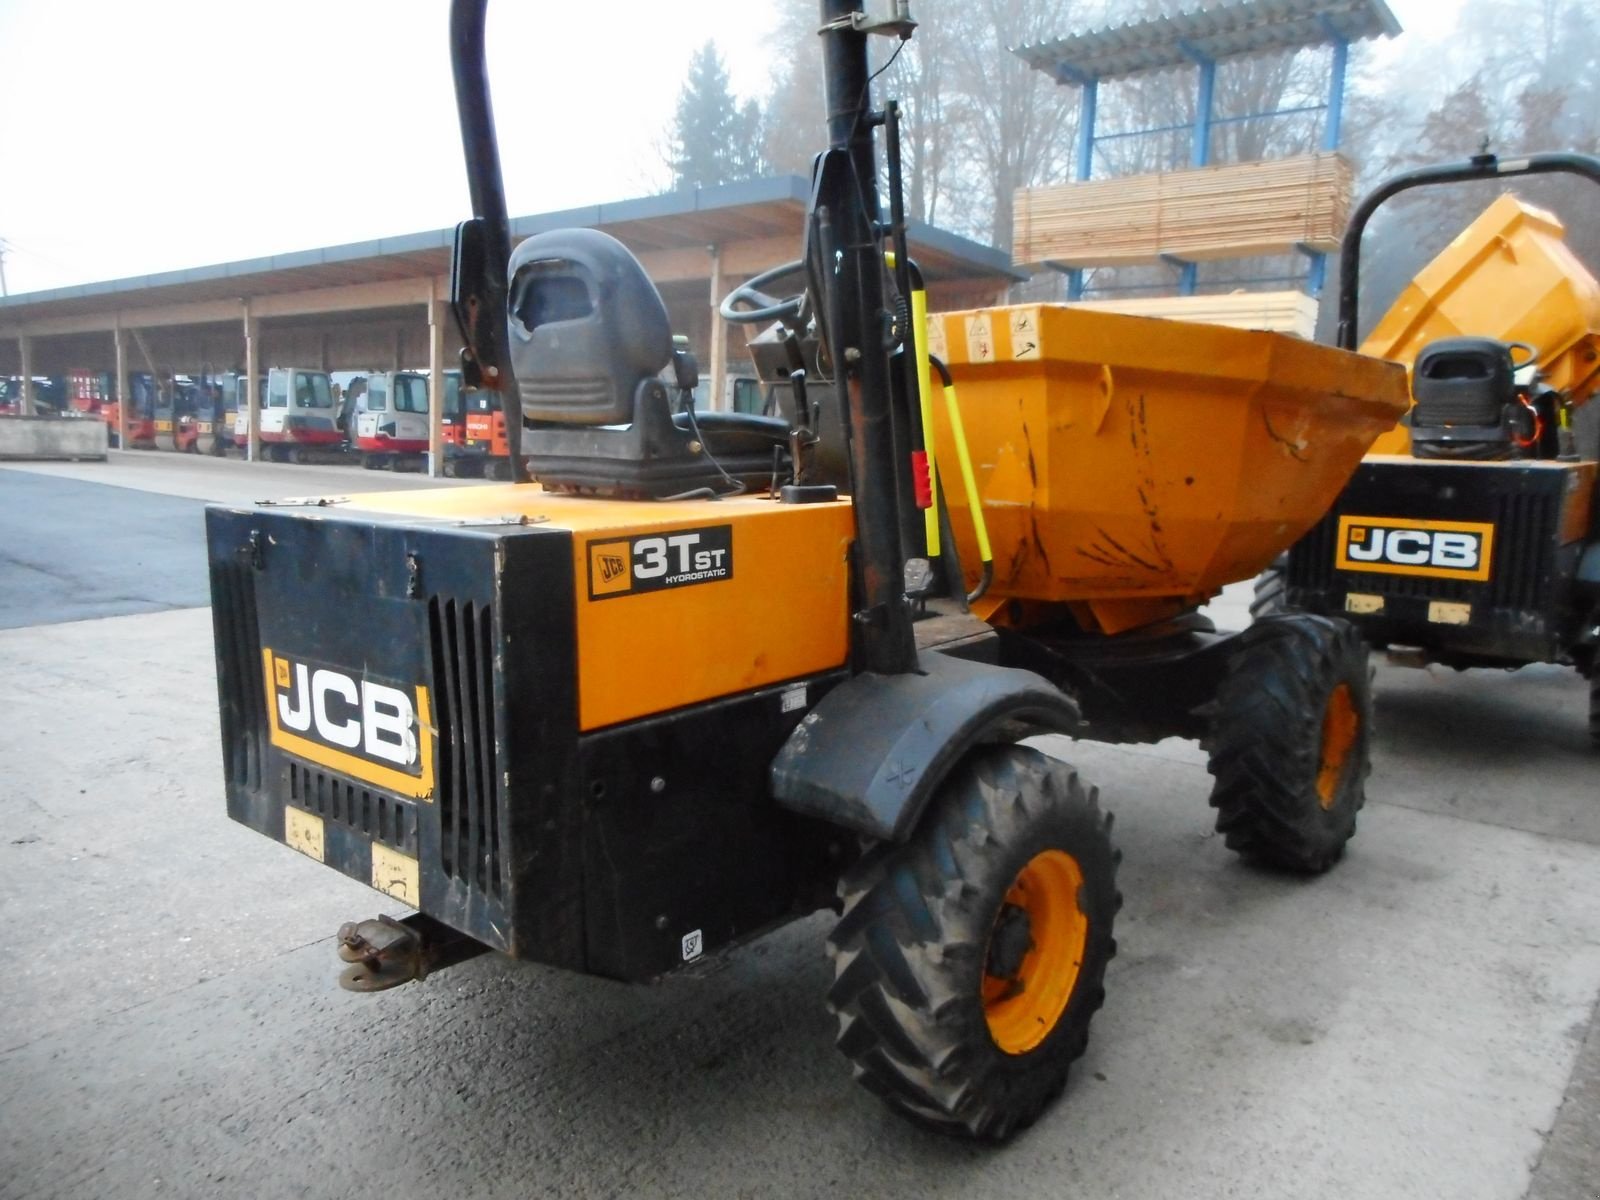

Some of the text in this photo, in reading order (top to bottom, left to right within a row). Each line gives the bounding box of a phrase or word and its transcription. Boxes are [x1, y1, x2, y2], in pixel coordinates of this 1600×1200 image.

[1349, 528, 1478, 568] JCB
[602, 556, 625, 580] JCB
[665, 568, 726, 584] HYDROSTATIC
[278, 663, 417, 766] JCB
